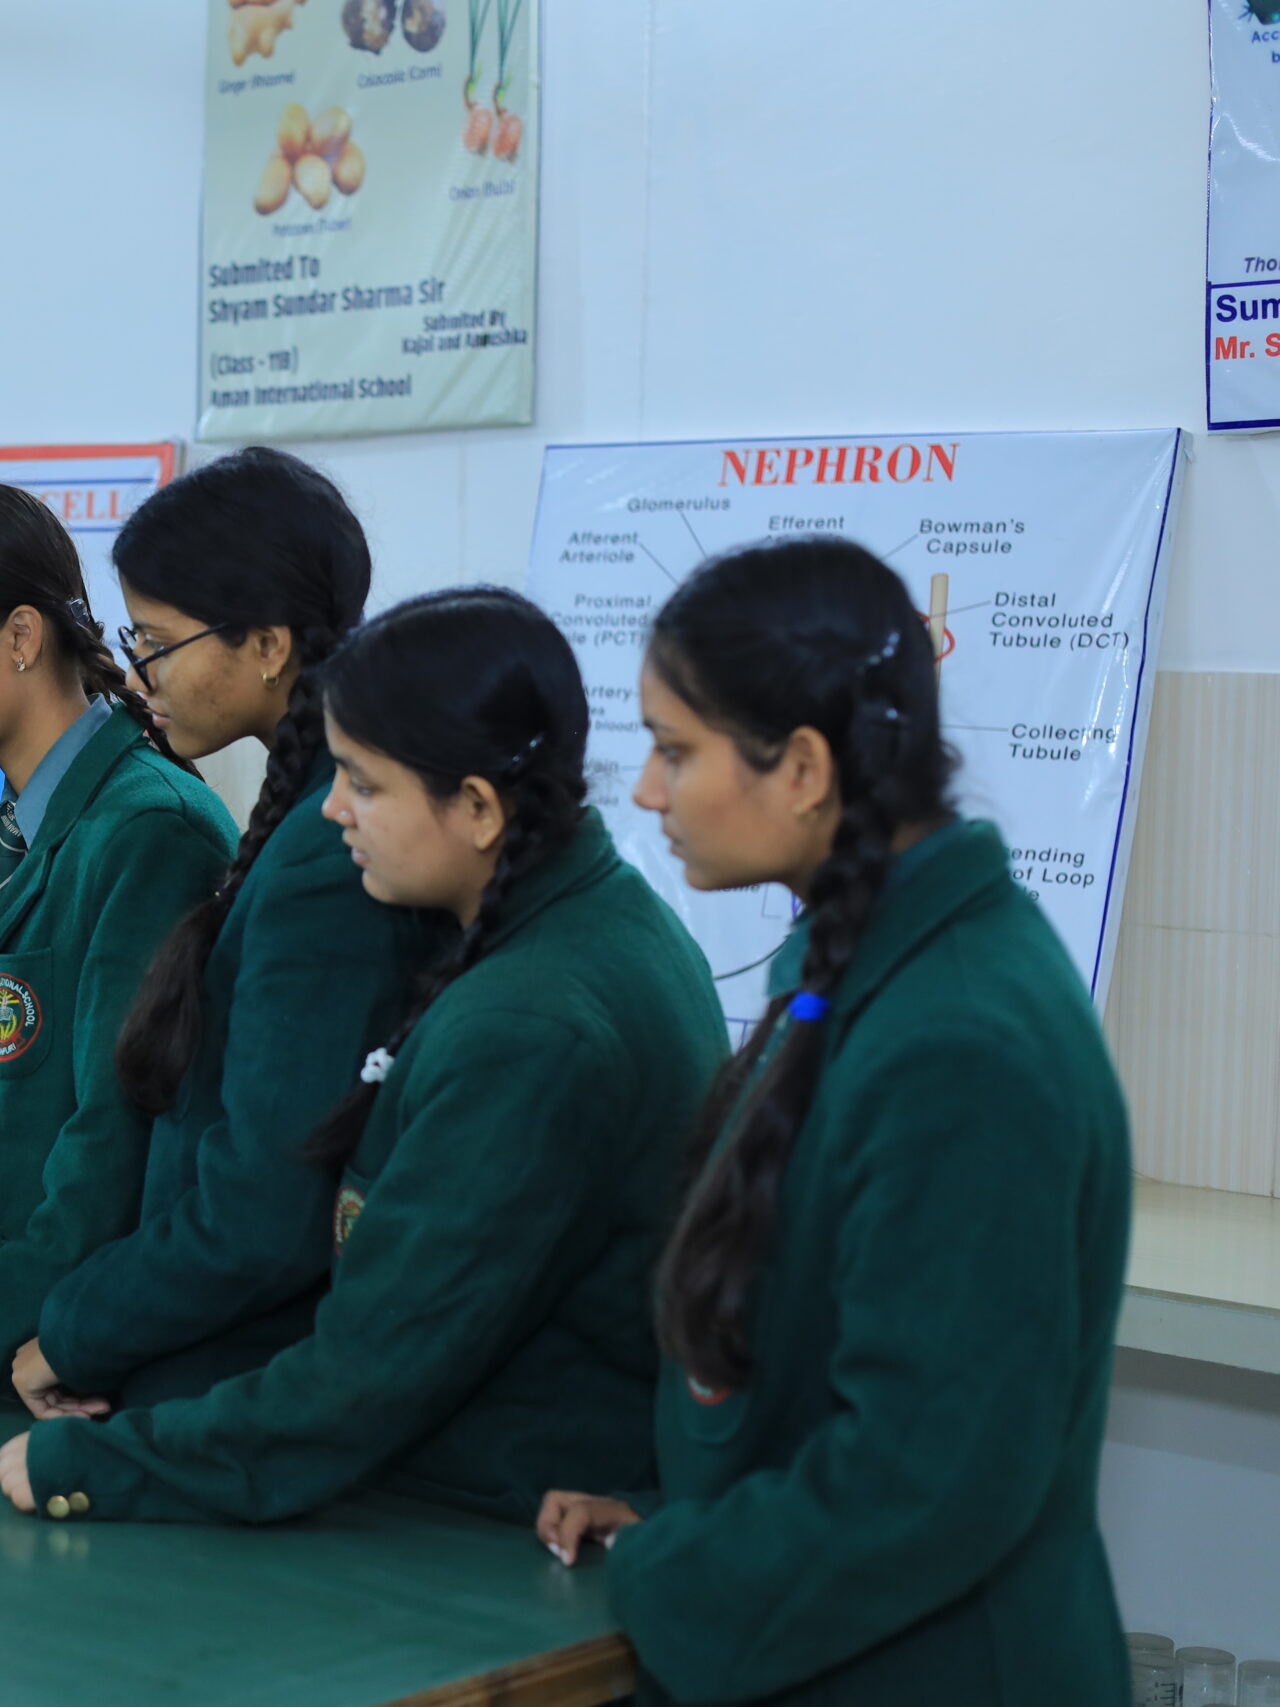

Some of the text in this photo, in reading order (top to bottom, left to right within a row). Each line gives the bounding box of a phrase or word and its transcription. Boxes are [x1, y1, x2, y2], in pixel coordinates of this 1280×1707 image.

[209, 256, 321, 287] Submited To
[1244, 257, 1280, 274] Tho
[209, 277, 446, 326] Shyam Sundar Sharma Sir
[438, 334, 462, 351] and
[1215, 336, 1256, 360] Mr.
[211, 373, 412, 409] Aman International School
[718, 443, 960, 487] NEPHRON
[627, 496, 732, 513] Glomerulus
[768, 514, 845, 531] Efferent
[919, 518, 1025, 535] Bowman's
[569, 531, 639, 545] Afferent
[926, 538, 1013, 556] Capsule
[559, 549, 635, 563] Arteriole
[574, 593, 652, 609] Proximal
[994, 591, 1057, 608] Distal
[991, 611, 1115, 628] Convoluted
[989, 632, 1130, 651] Tubule (DCT)
[1009, 743, 1082, 761] Tubule
[1011, 848, 1085, 868] ending
[1013, 867, 1095, 889] of Loop
